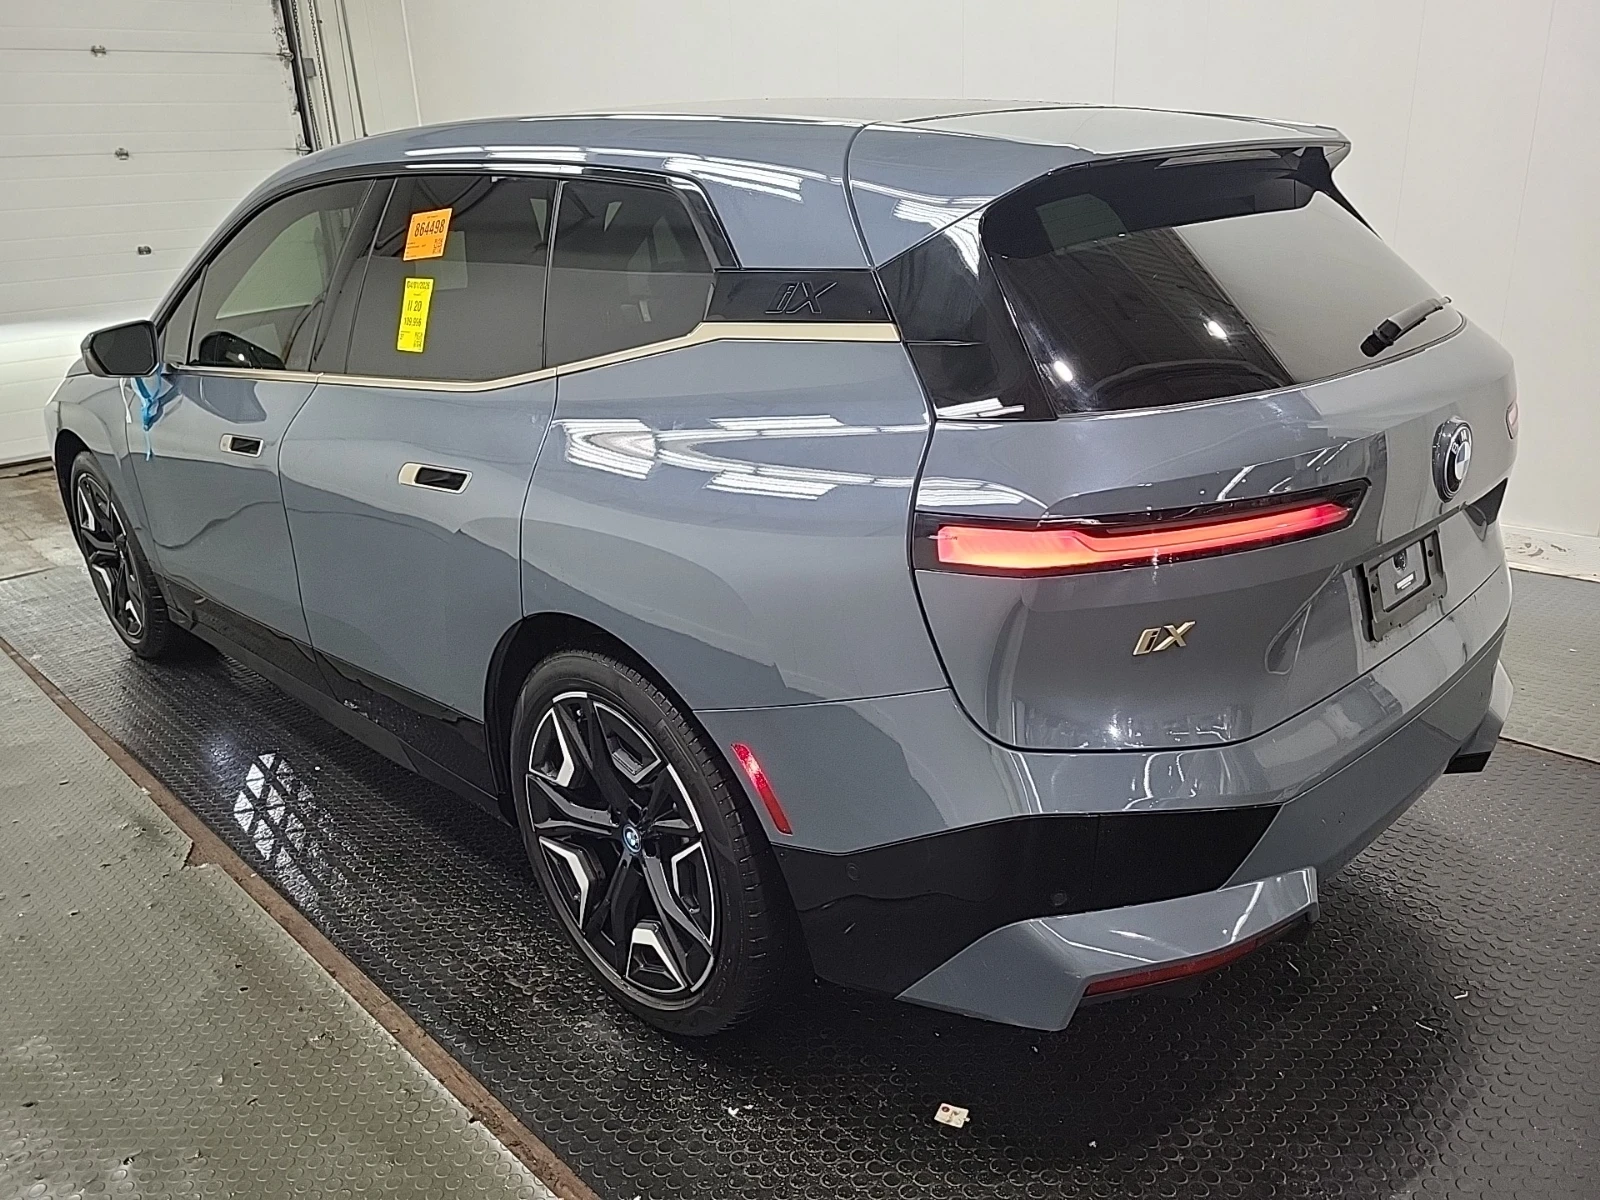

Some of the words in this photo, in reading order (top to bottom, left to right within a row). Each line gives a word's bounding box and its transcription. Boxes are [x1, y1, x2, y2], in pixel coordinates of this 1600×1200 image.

[414, 218, 446, 237] 864498
[413, 300, 423, 312] 20
[1133, 620, 1196, 655] iX
